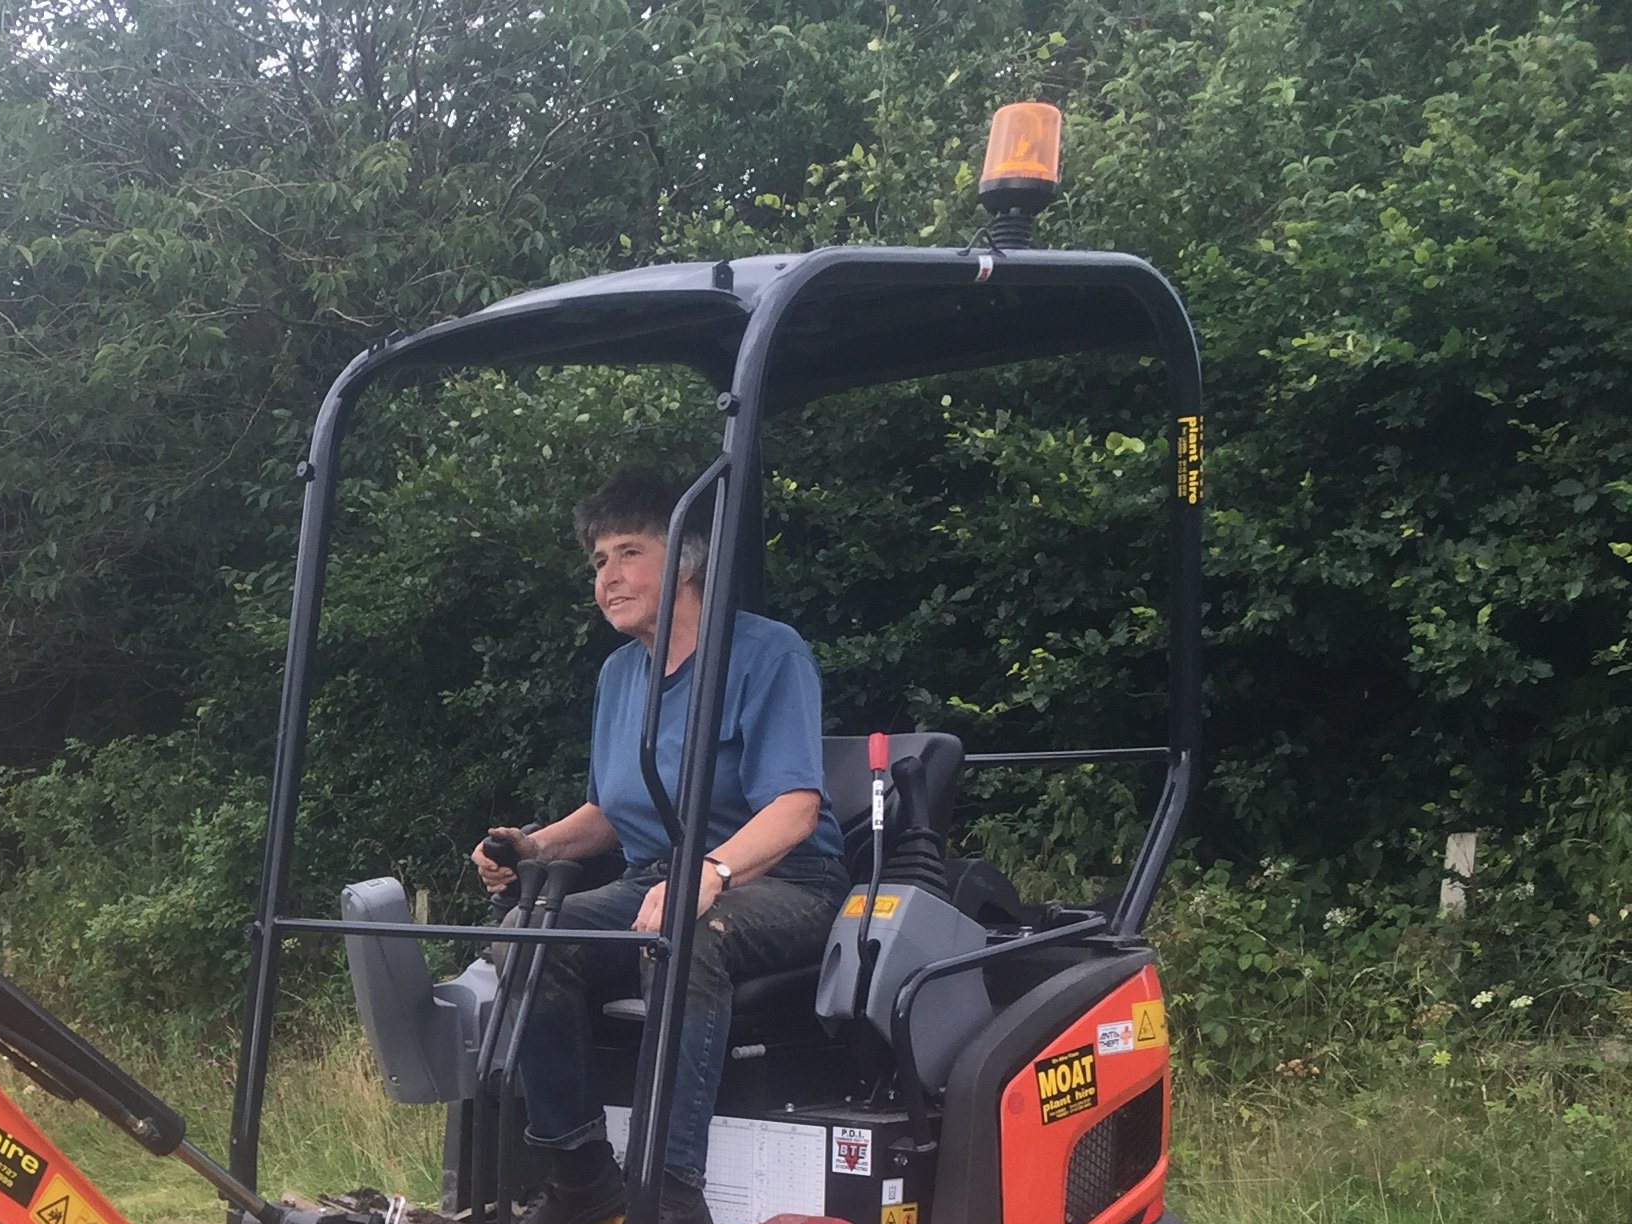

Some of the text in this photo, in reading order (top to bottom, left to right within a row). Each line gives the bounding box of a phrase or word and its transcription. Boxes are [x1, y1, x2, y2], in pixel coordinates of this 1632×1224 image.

[1177, 416, 1199, 462] plant
[1188, 470, 1199, 504] hire
[1038, 1054, 1094, 1100] MOAT
[1042, 1094, 1072, 1123] plant
[1075, 1086, 1096, 1101] hire
[839, 1144, 867, 1158] BTE
